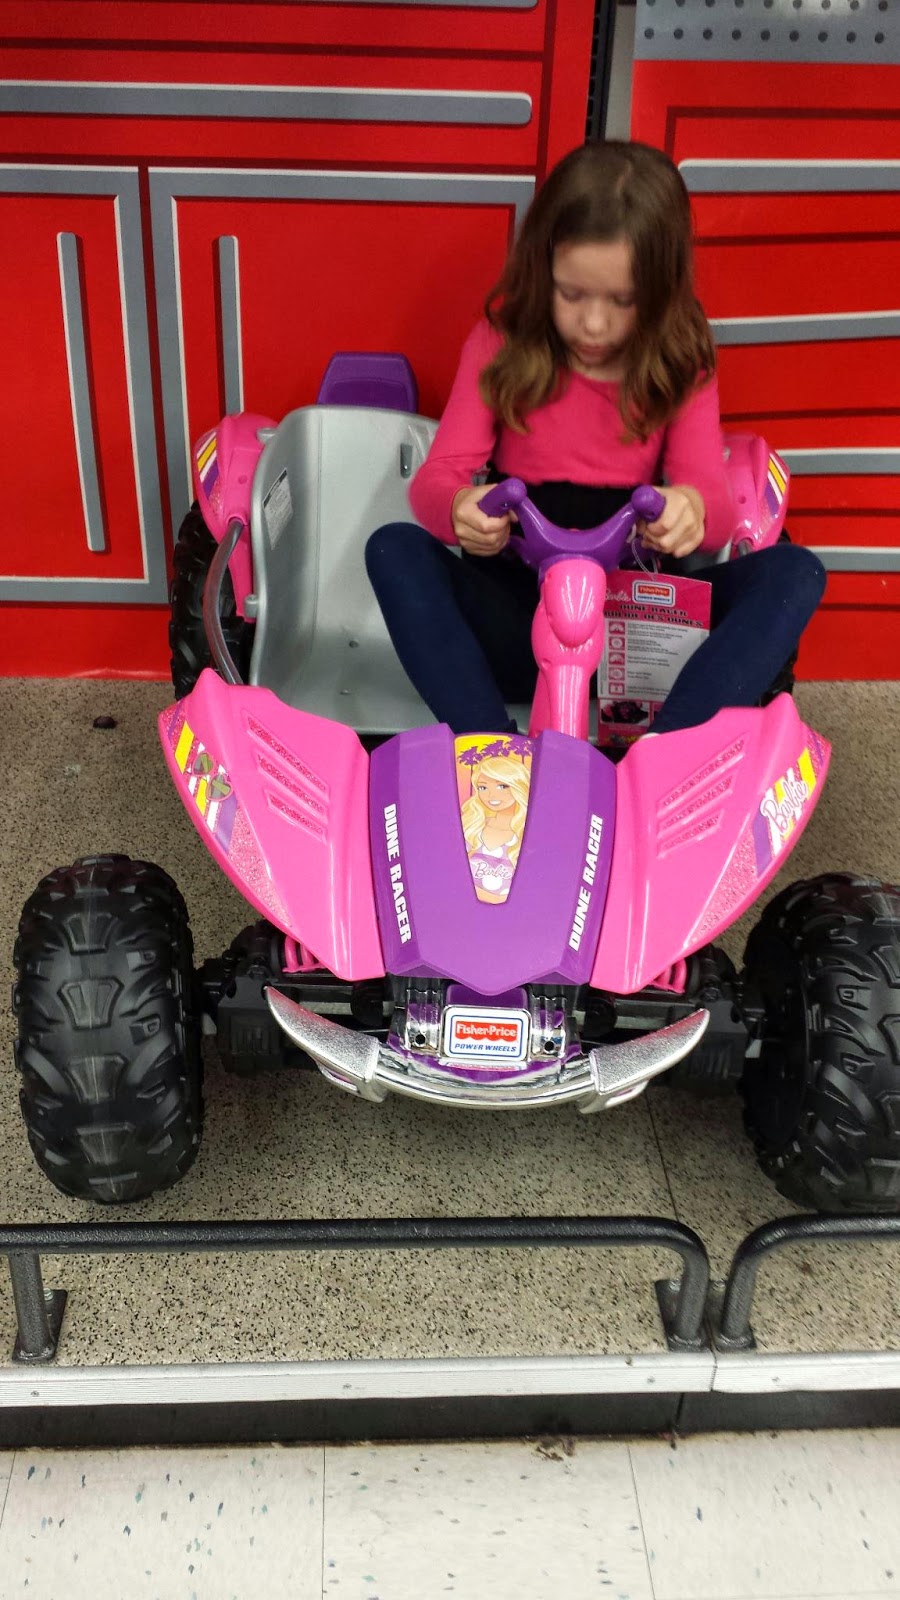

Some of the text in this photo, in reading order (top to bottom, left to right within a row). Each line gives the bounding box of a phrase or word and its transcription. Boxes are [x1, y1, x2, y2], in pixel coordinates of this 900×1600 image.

[763, 781, 807, 833] Barbie
[384, 803, 412, 944] DUNE RACER
[474, 861, 512, 878] Barbie
[568, 814, 604, 951] DUNE RACER
[456, 1024, 517, 1037] Fisher-Price
